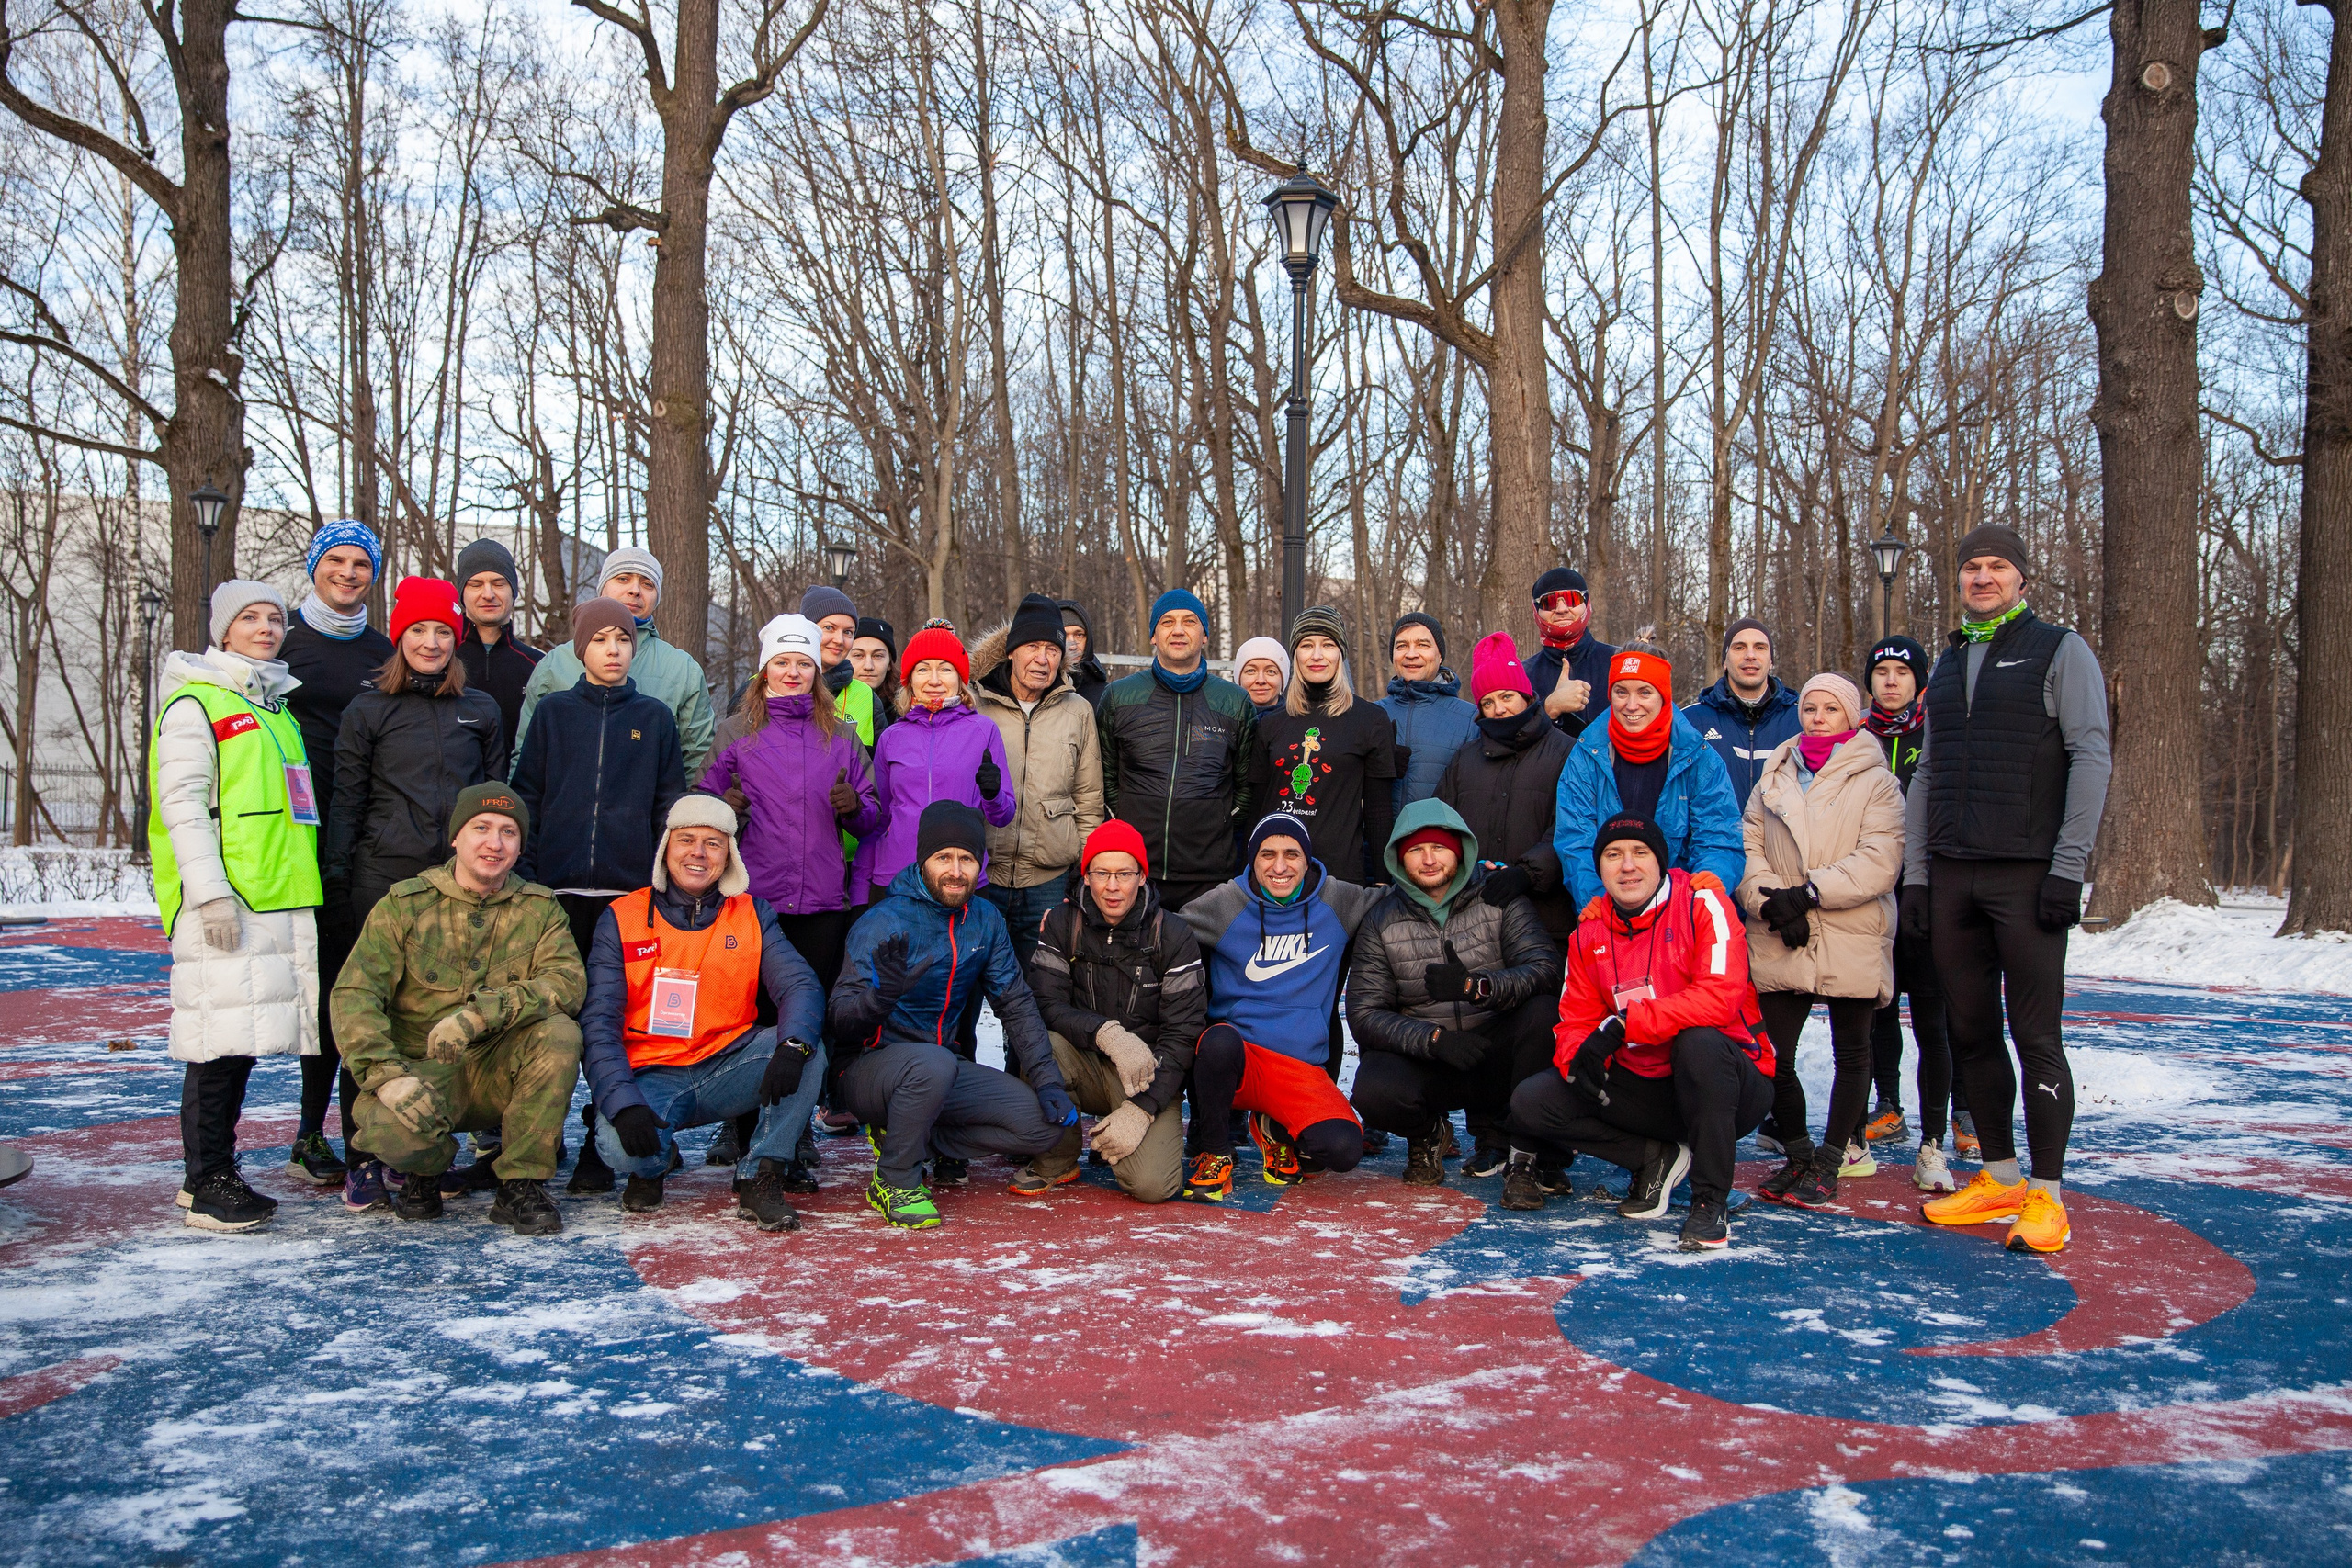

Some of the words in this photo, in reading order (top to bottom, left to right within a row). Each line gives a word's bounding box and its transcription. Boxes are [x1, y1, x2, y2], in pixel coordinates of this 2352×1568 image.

[1874, 647, 1910, 660] FILA
[1282, 800, 1294, 813] 23
[1255, 932, 1313, 961] NIKE
